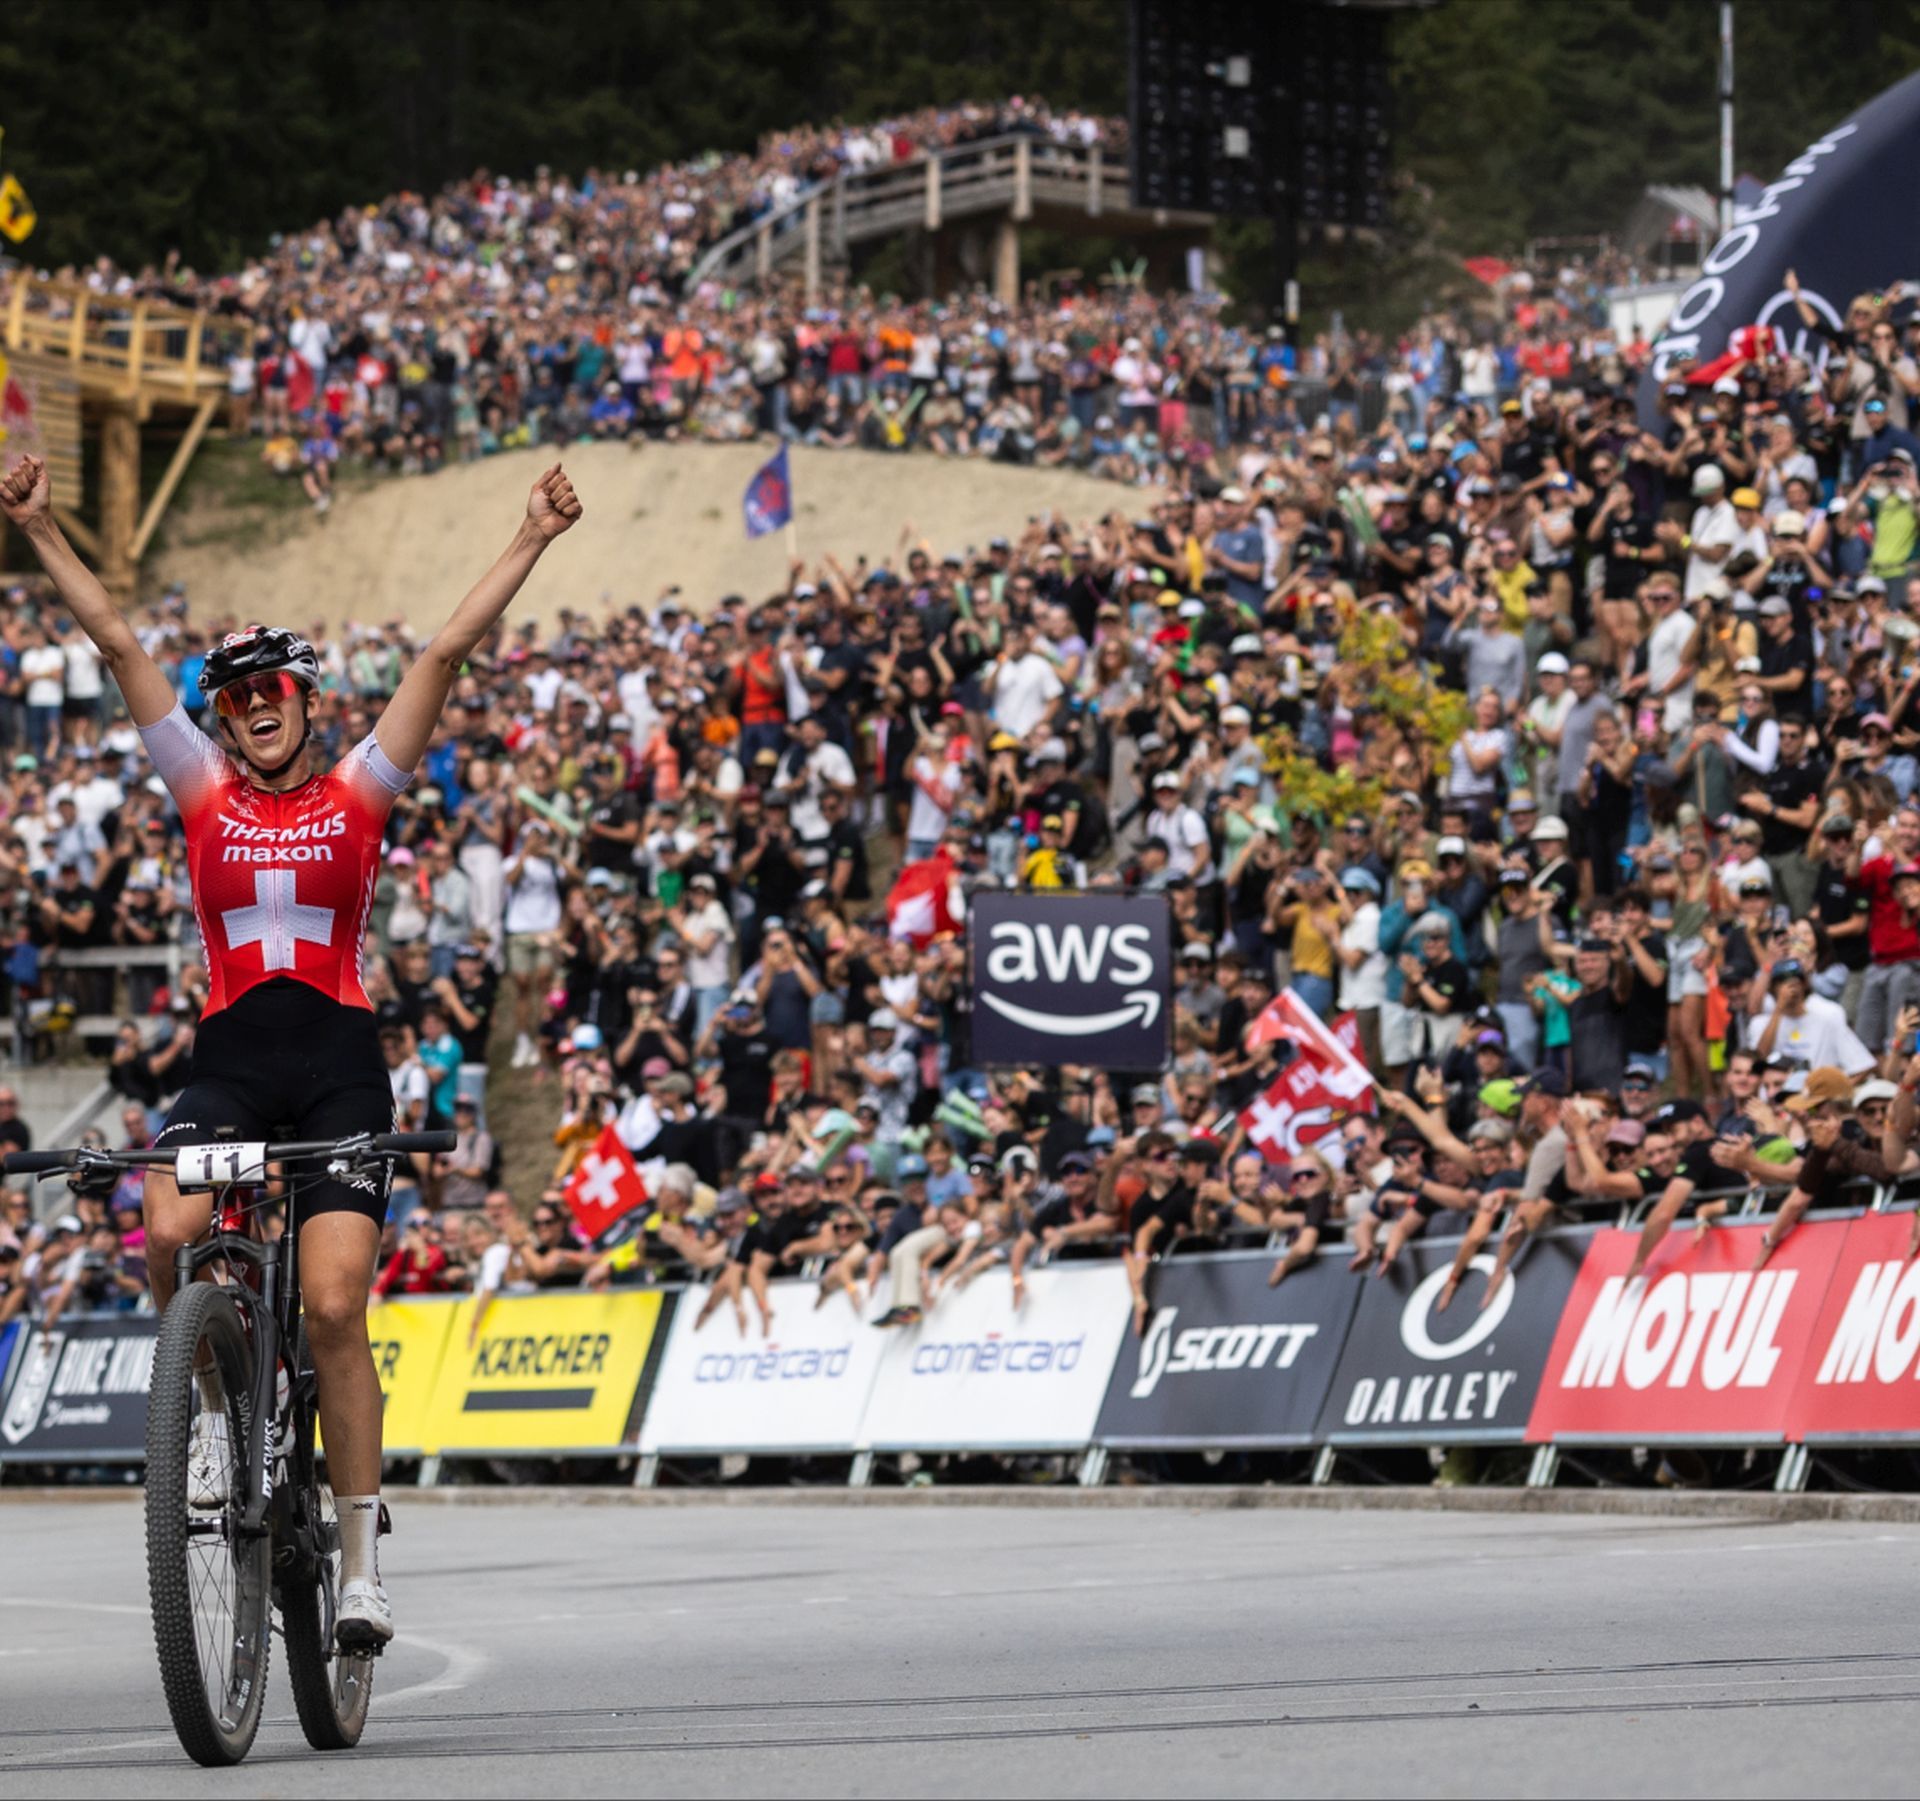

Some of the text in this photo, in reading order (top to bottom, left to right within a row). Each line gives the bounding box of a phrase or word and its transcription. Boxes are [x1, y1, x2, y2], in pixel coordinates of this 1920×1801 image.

[222, 845, 333, 862] maxon
[987, 921, 1154, 986] aws
[197, 1151, 240, 1180] 11
[1164, 1323, 1320, 1373] SCOTT
[1559, 1268, 1799, 1391] MOTUL
[1814, 1258, 1920, 1385] MO
[1344, 1370, 1516, 1426] OAKLEY
[263, 1418, 276, 1467] SWISS
